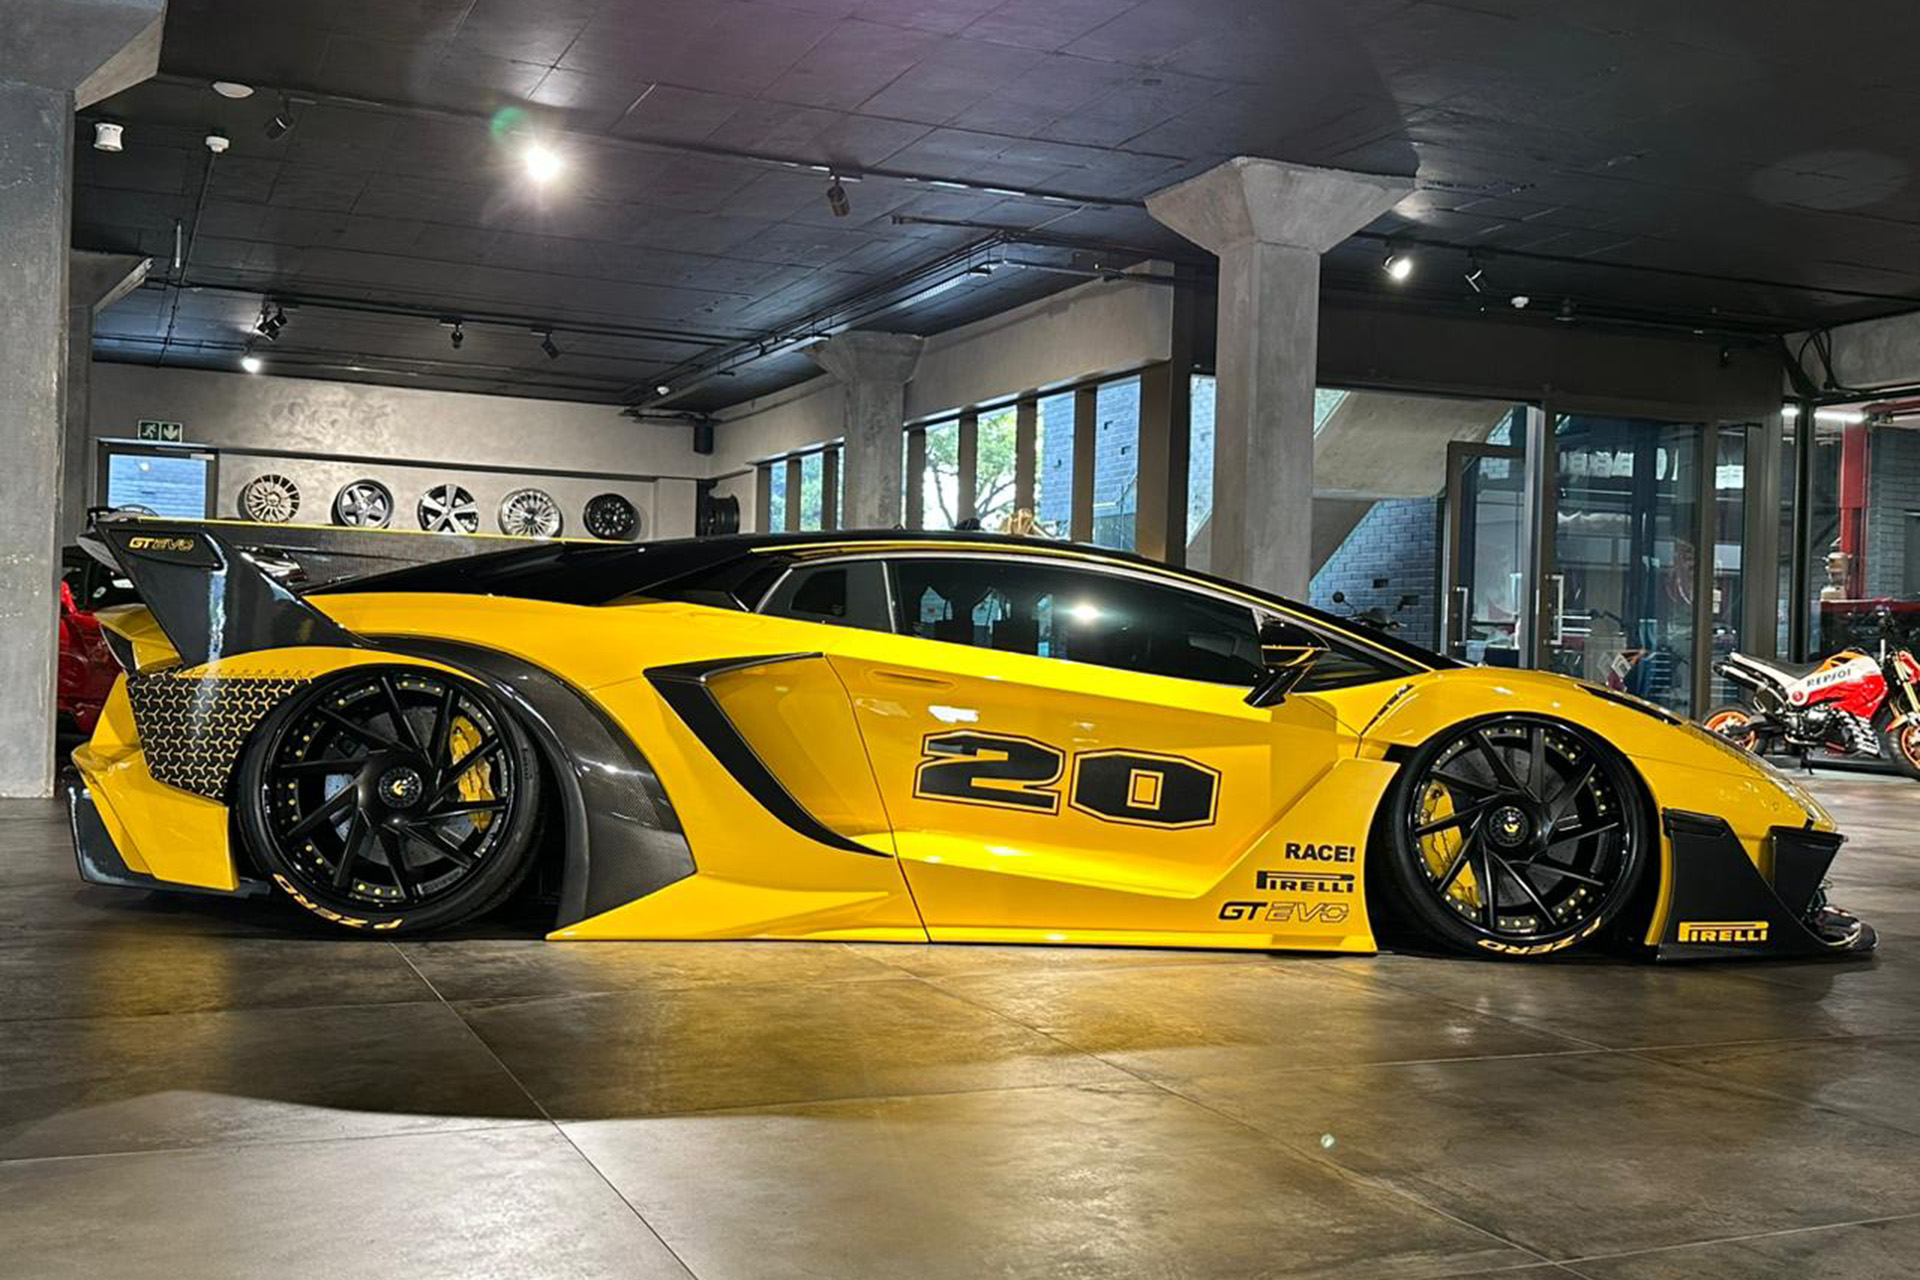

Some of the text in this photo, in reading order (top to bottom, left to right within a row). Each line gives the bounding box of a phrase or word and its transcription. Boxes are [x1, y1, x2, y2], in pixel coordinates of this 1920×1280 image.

[912, 728, 1222, 831] 20
[1285, 843, 1356, 862] RACE!
[1256, 870, 1355, 893] PIRELLI
[1678, 921, 1769, 942] PIRELLI
